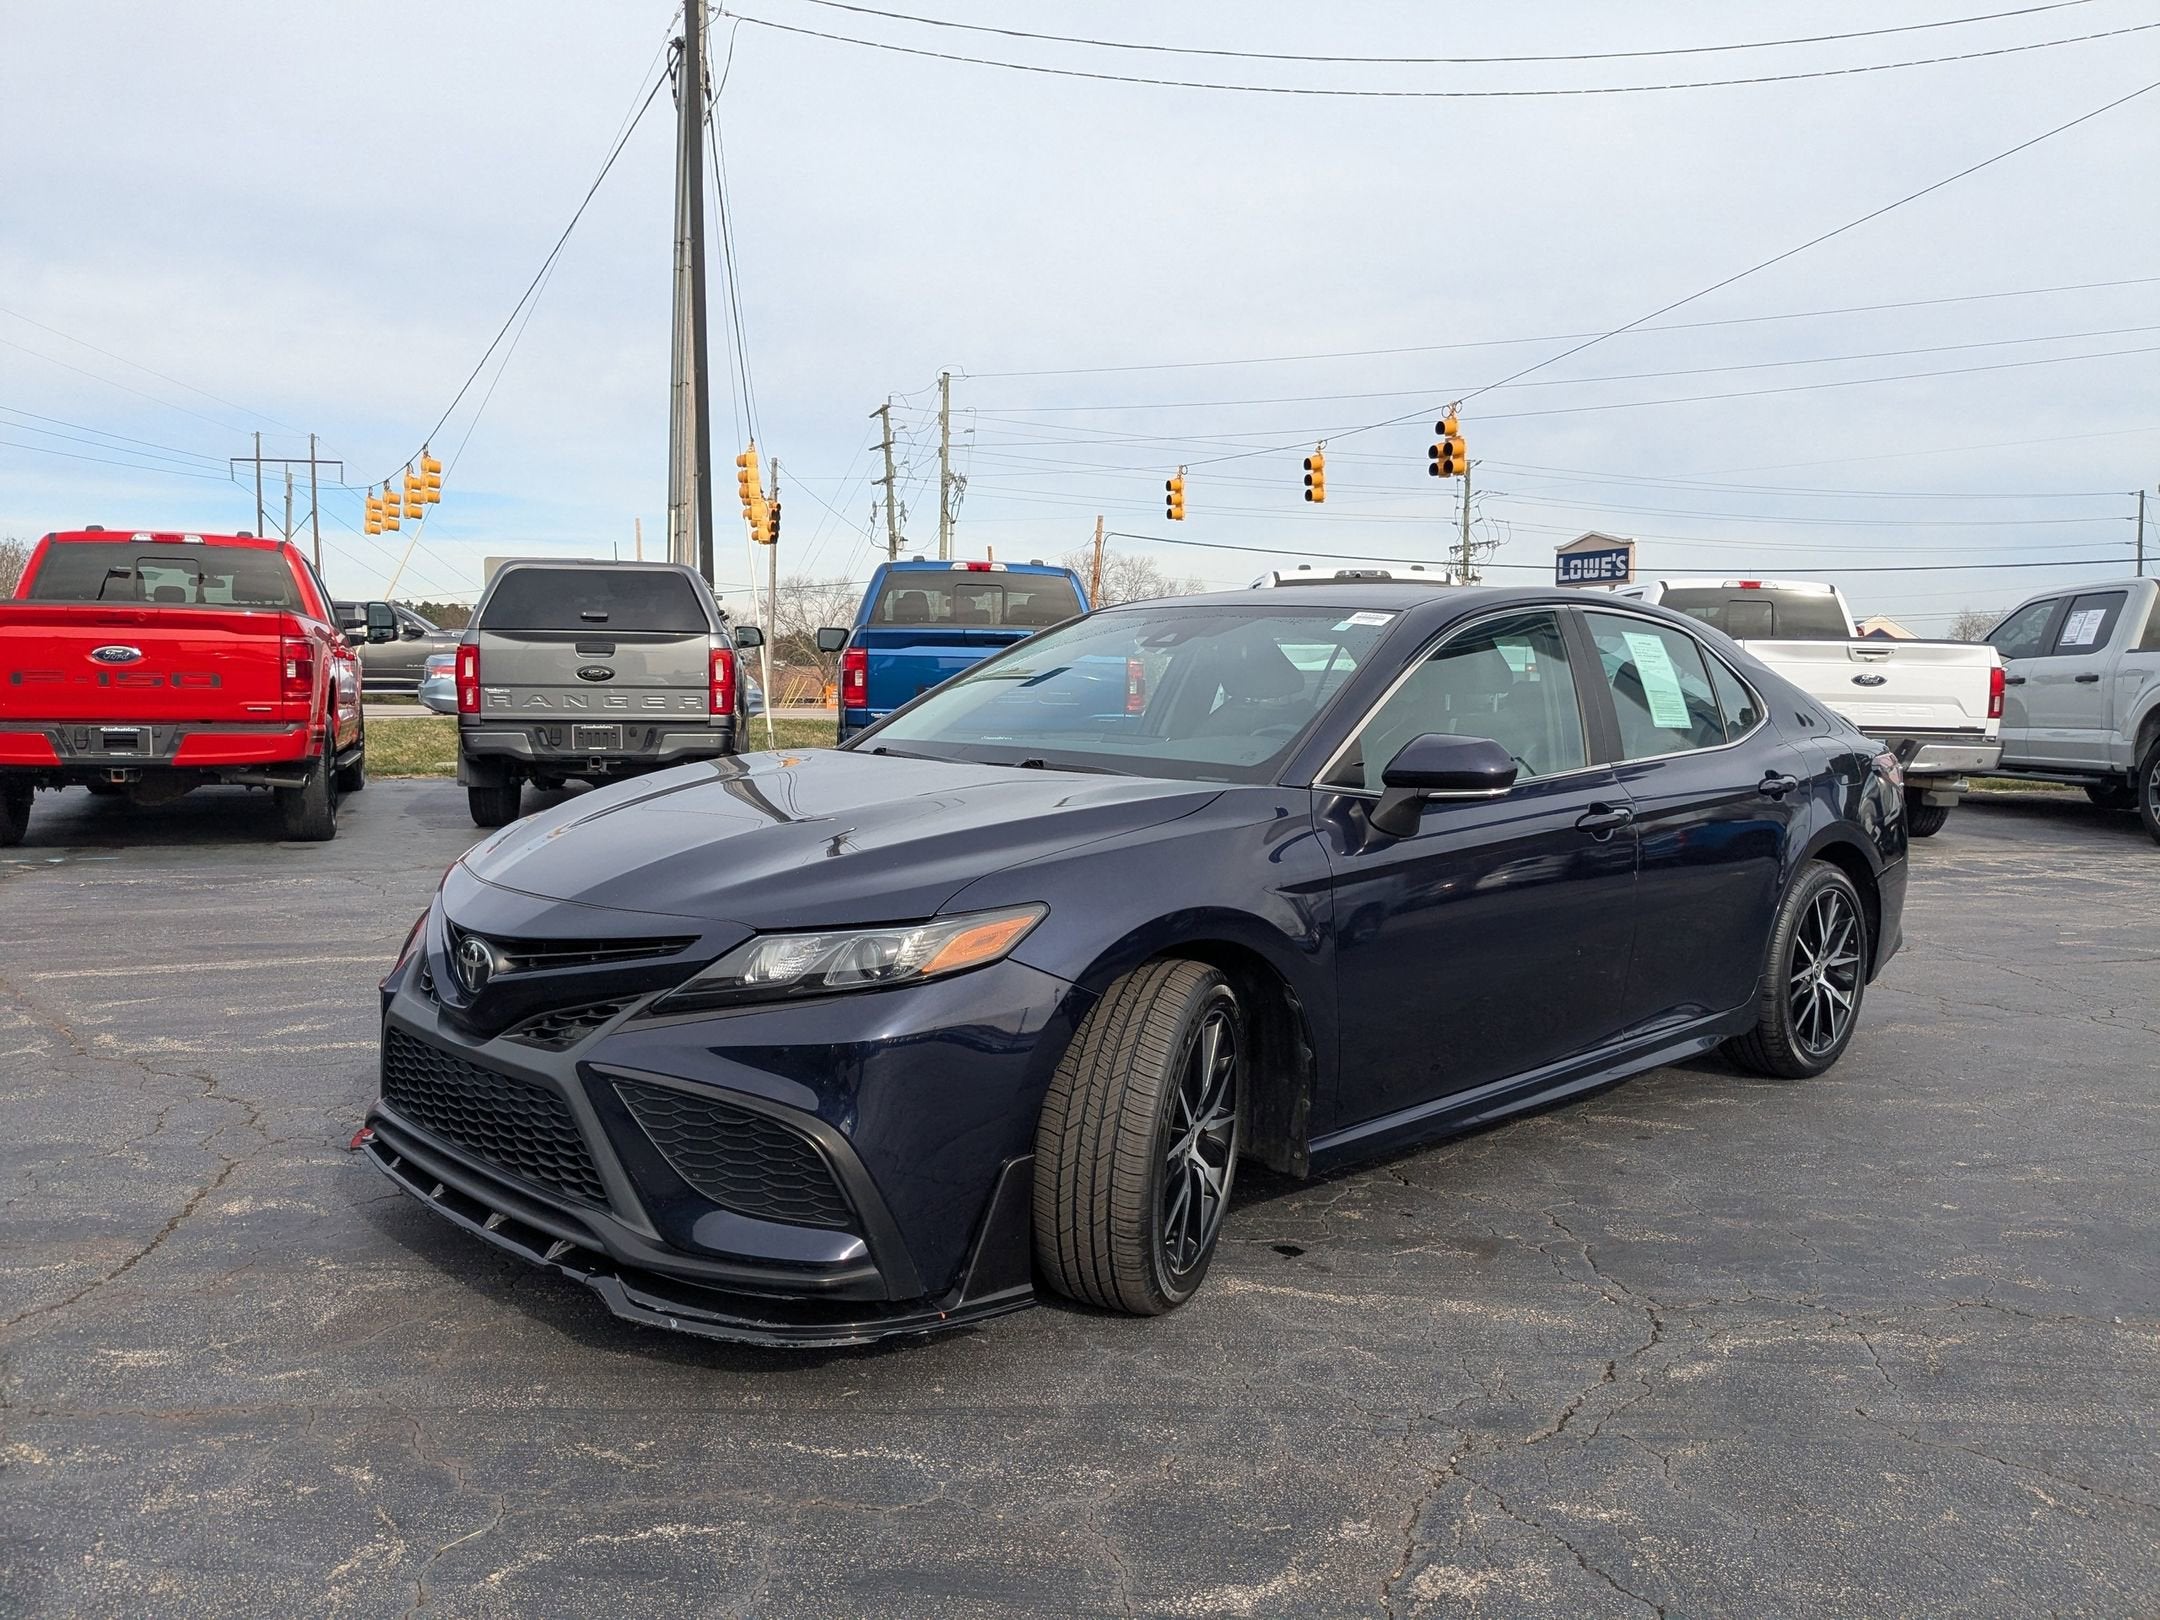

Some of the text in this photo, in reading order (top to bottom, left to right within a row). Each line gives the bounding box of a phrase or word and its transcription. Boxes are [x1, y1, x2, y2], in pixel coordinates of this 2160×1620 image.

[1558, 553, 1627, 581] LOWE'S
[10, 670, 223, 689] F-150
[486, 694, 703, 709] RANGER
